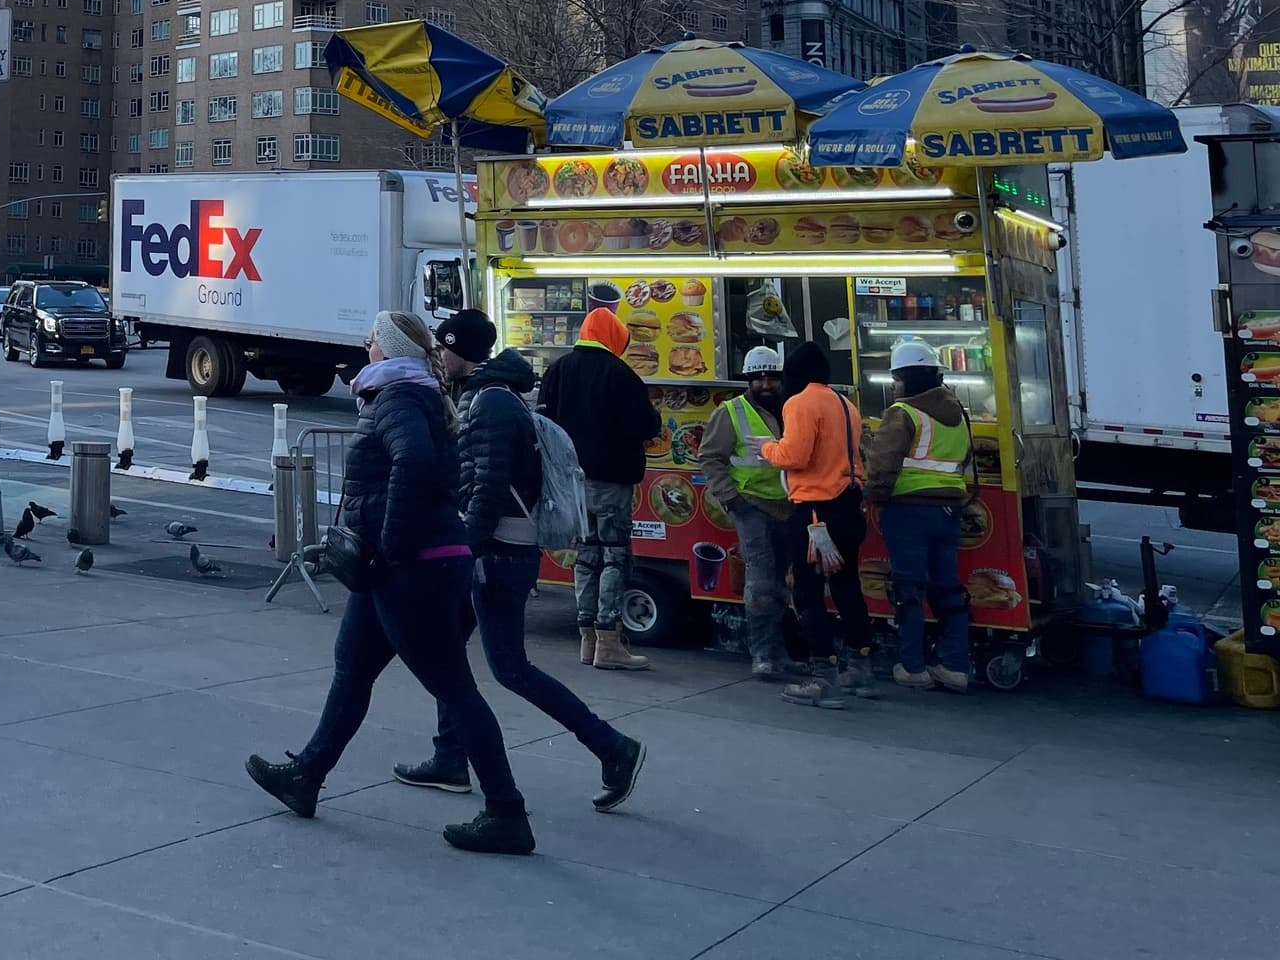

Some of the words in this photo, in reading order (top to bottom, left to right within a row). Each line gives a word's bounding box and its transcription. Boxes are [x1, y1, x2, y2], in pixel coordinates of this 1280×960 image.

[653, 65, 746, 90] SABRETT
[938, 78, 1041, 104] SABRETT
[639, 110, 787, 140] SABRETT
[844, 143, 856, 152] ON
[858, 143, 864, 152] A
[864, 143, 884, 152] ROLL
[923, 128, 1094, 158] SABRETT
[120, 199, 263, 282] FedEx
[198, 283, 242, 307] Ground
[874, 278, 902, 287] Accept
[638, 522, 662, 530] Accept
